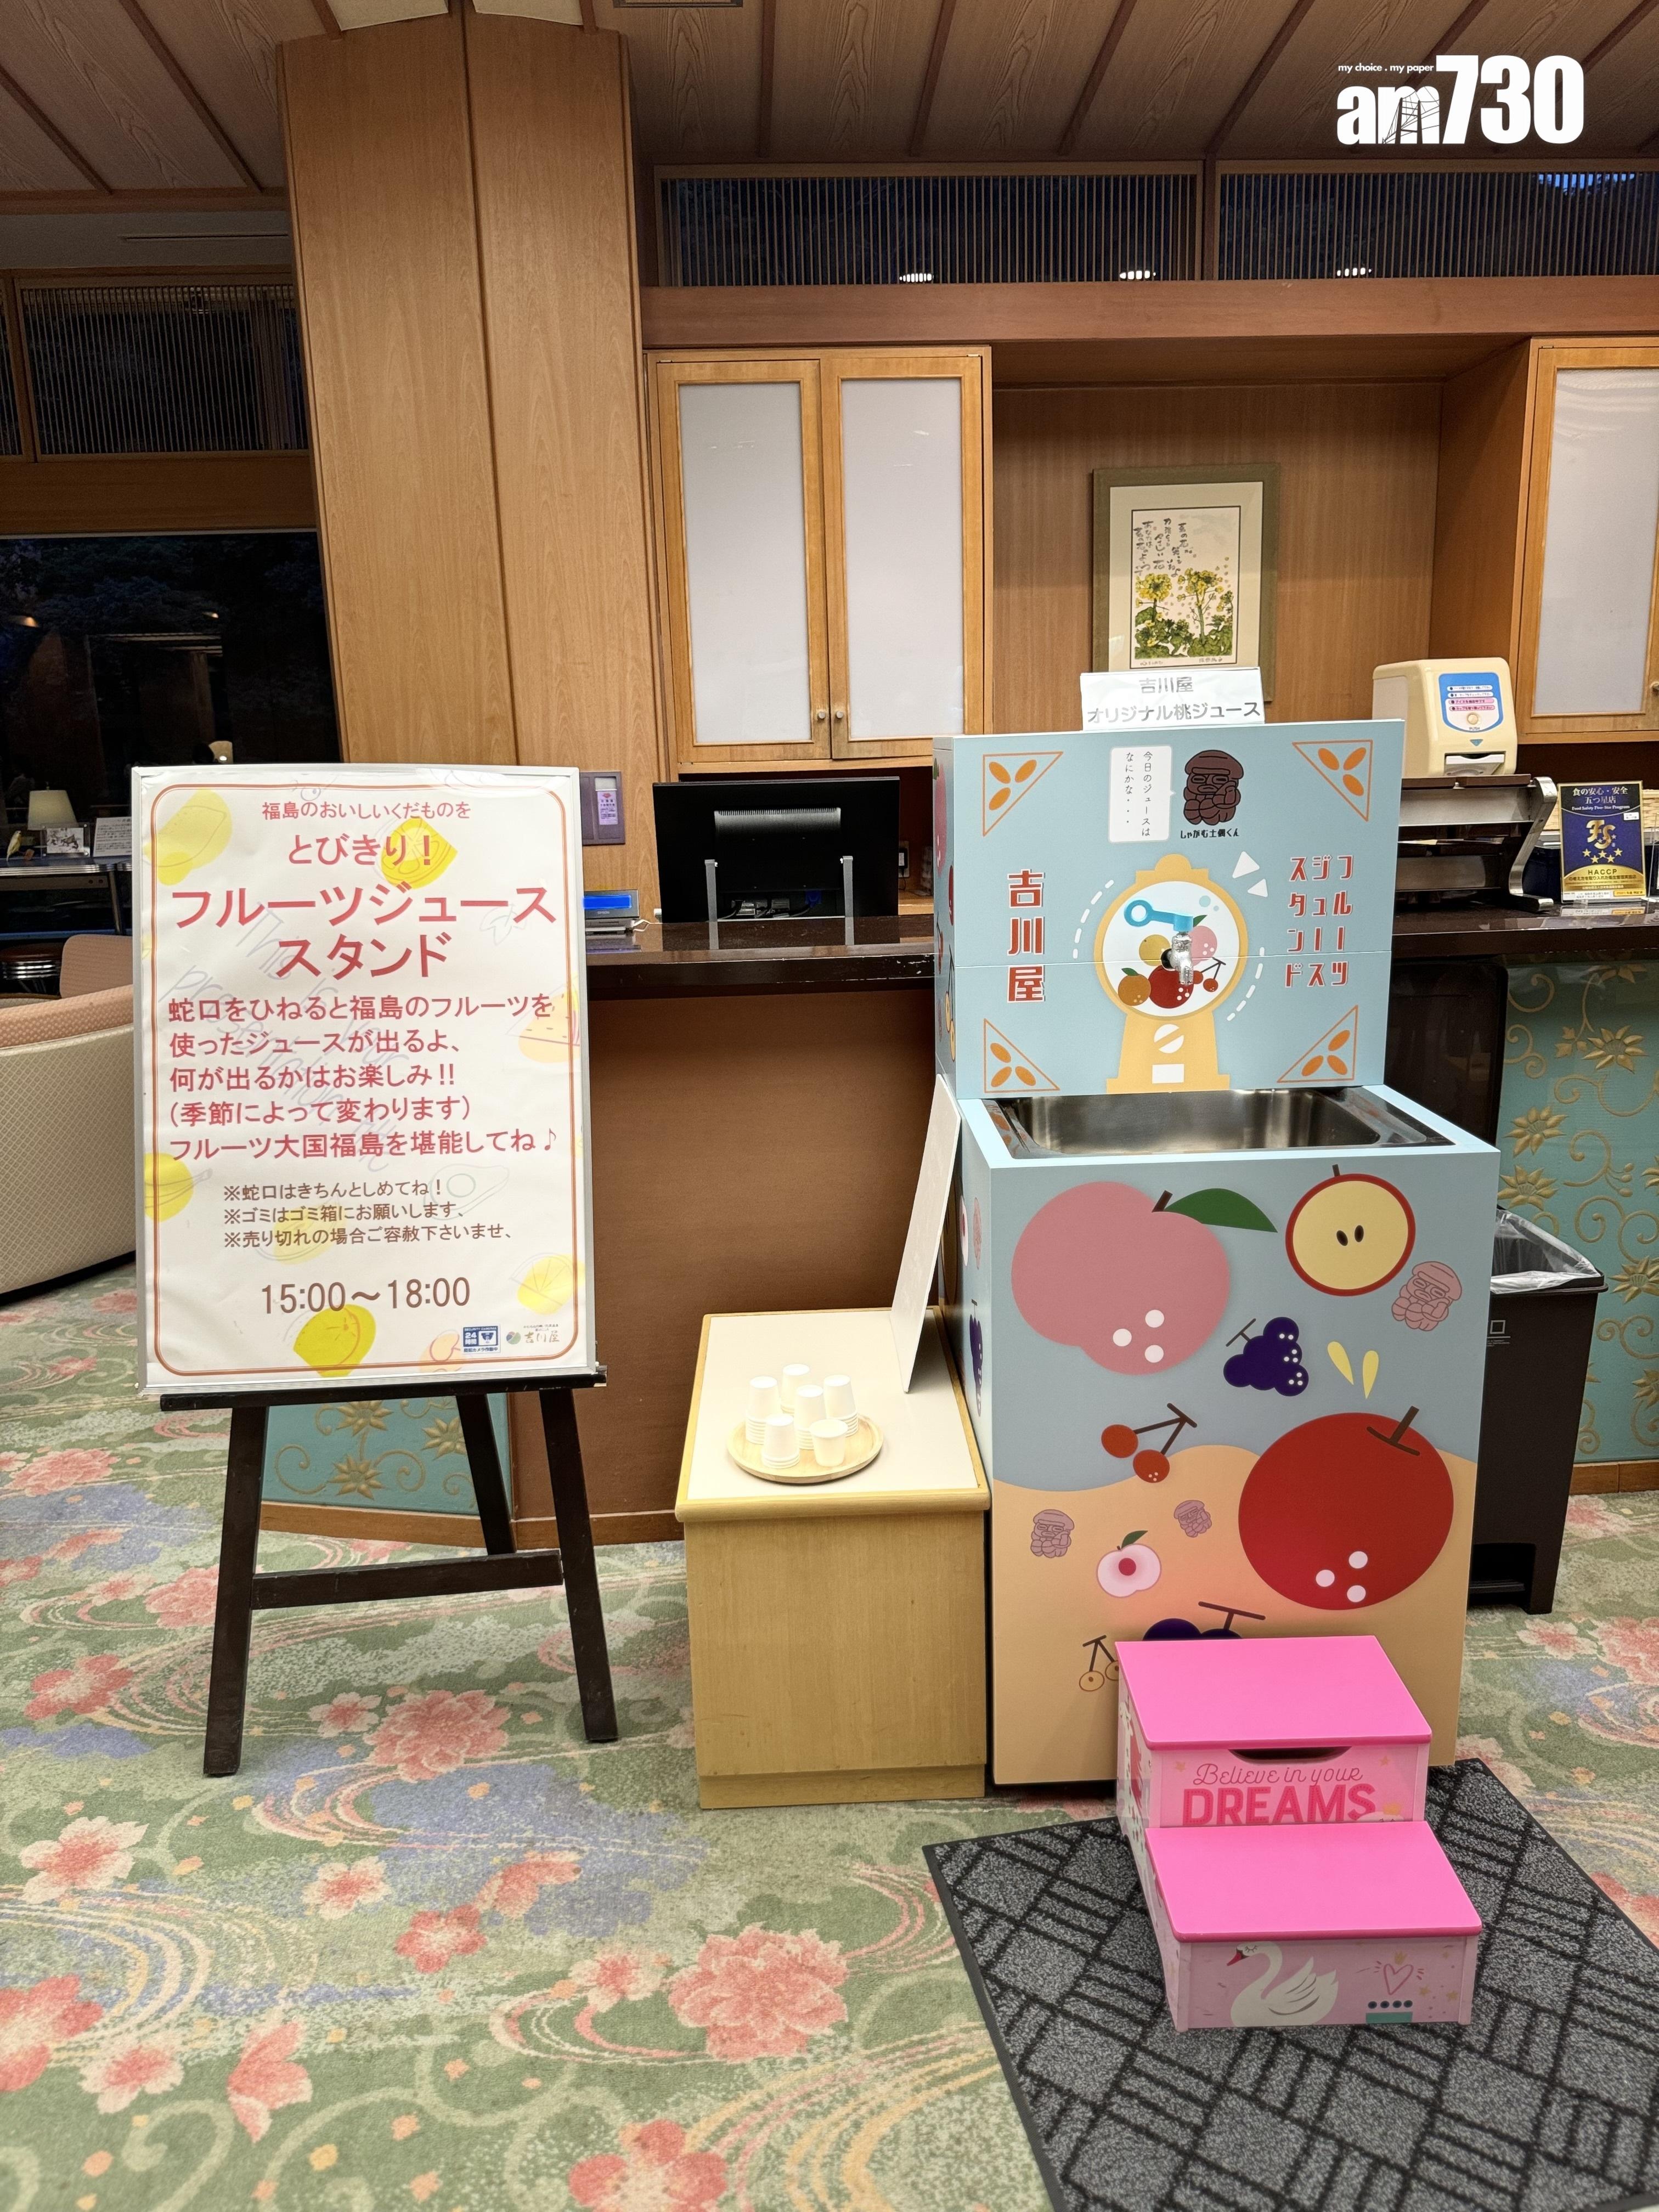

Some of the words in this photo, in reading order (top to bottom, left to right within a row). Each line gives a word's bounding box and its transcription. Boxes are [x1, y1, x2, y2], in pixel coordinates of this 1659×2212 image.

[1139, 676, 1194, 693] 吉川屋
[1087, 702, 1260, 723] オリジナル桃ジュース
[1142, 752, 1153, 836] 今日のジュースは
[1573, 787, 1628, 796] 食の安心・安全
[1585, 796, 1616, 804] 五つ星店
[262, 800, 471, 820] 福島のおいしいくだものを
[1180, 828, 1239, 838] しゃがむ土偶くん
[289, 834, 431, 866] とびきり！
[172, 881, 556, 928] フルーツジュース
[1007, 868, 1046, 1003] 吉川屋
[1285, 856, 1307, 988] スタンド
[1307, 855, 1332, 987] ジュース
[1331, 855, 1353, 986] フルーツ
[275, 932, 452, 979] スタンド
[168, 994, 552, 1023] 蛇口をひねると福島のフルーツを
[170, 1029, 460, 1058] 使ったジュースが出るよ、
[1193, 1763, 1279, 1785] Believe
[1284, 1767, 1306, 1782] in
[1310, 1767, 1363, 1786] your
[1183, 1784, 1376, 1826] DREAMS
